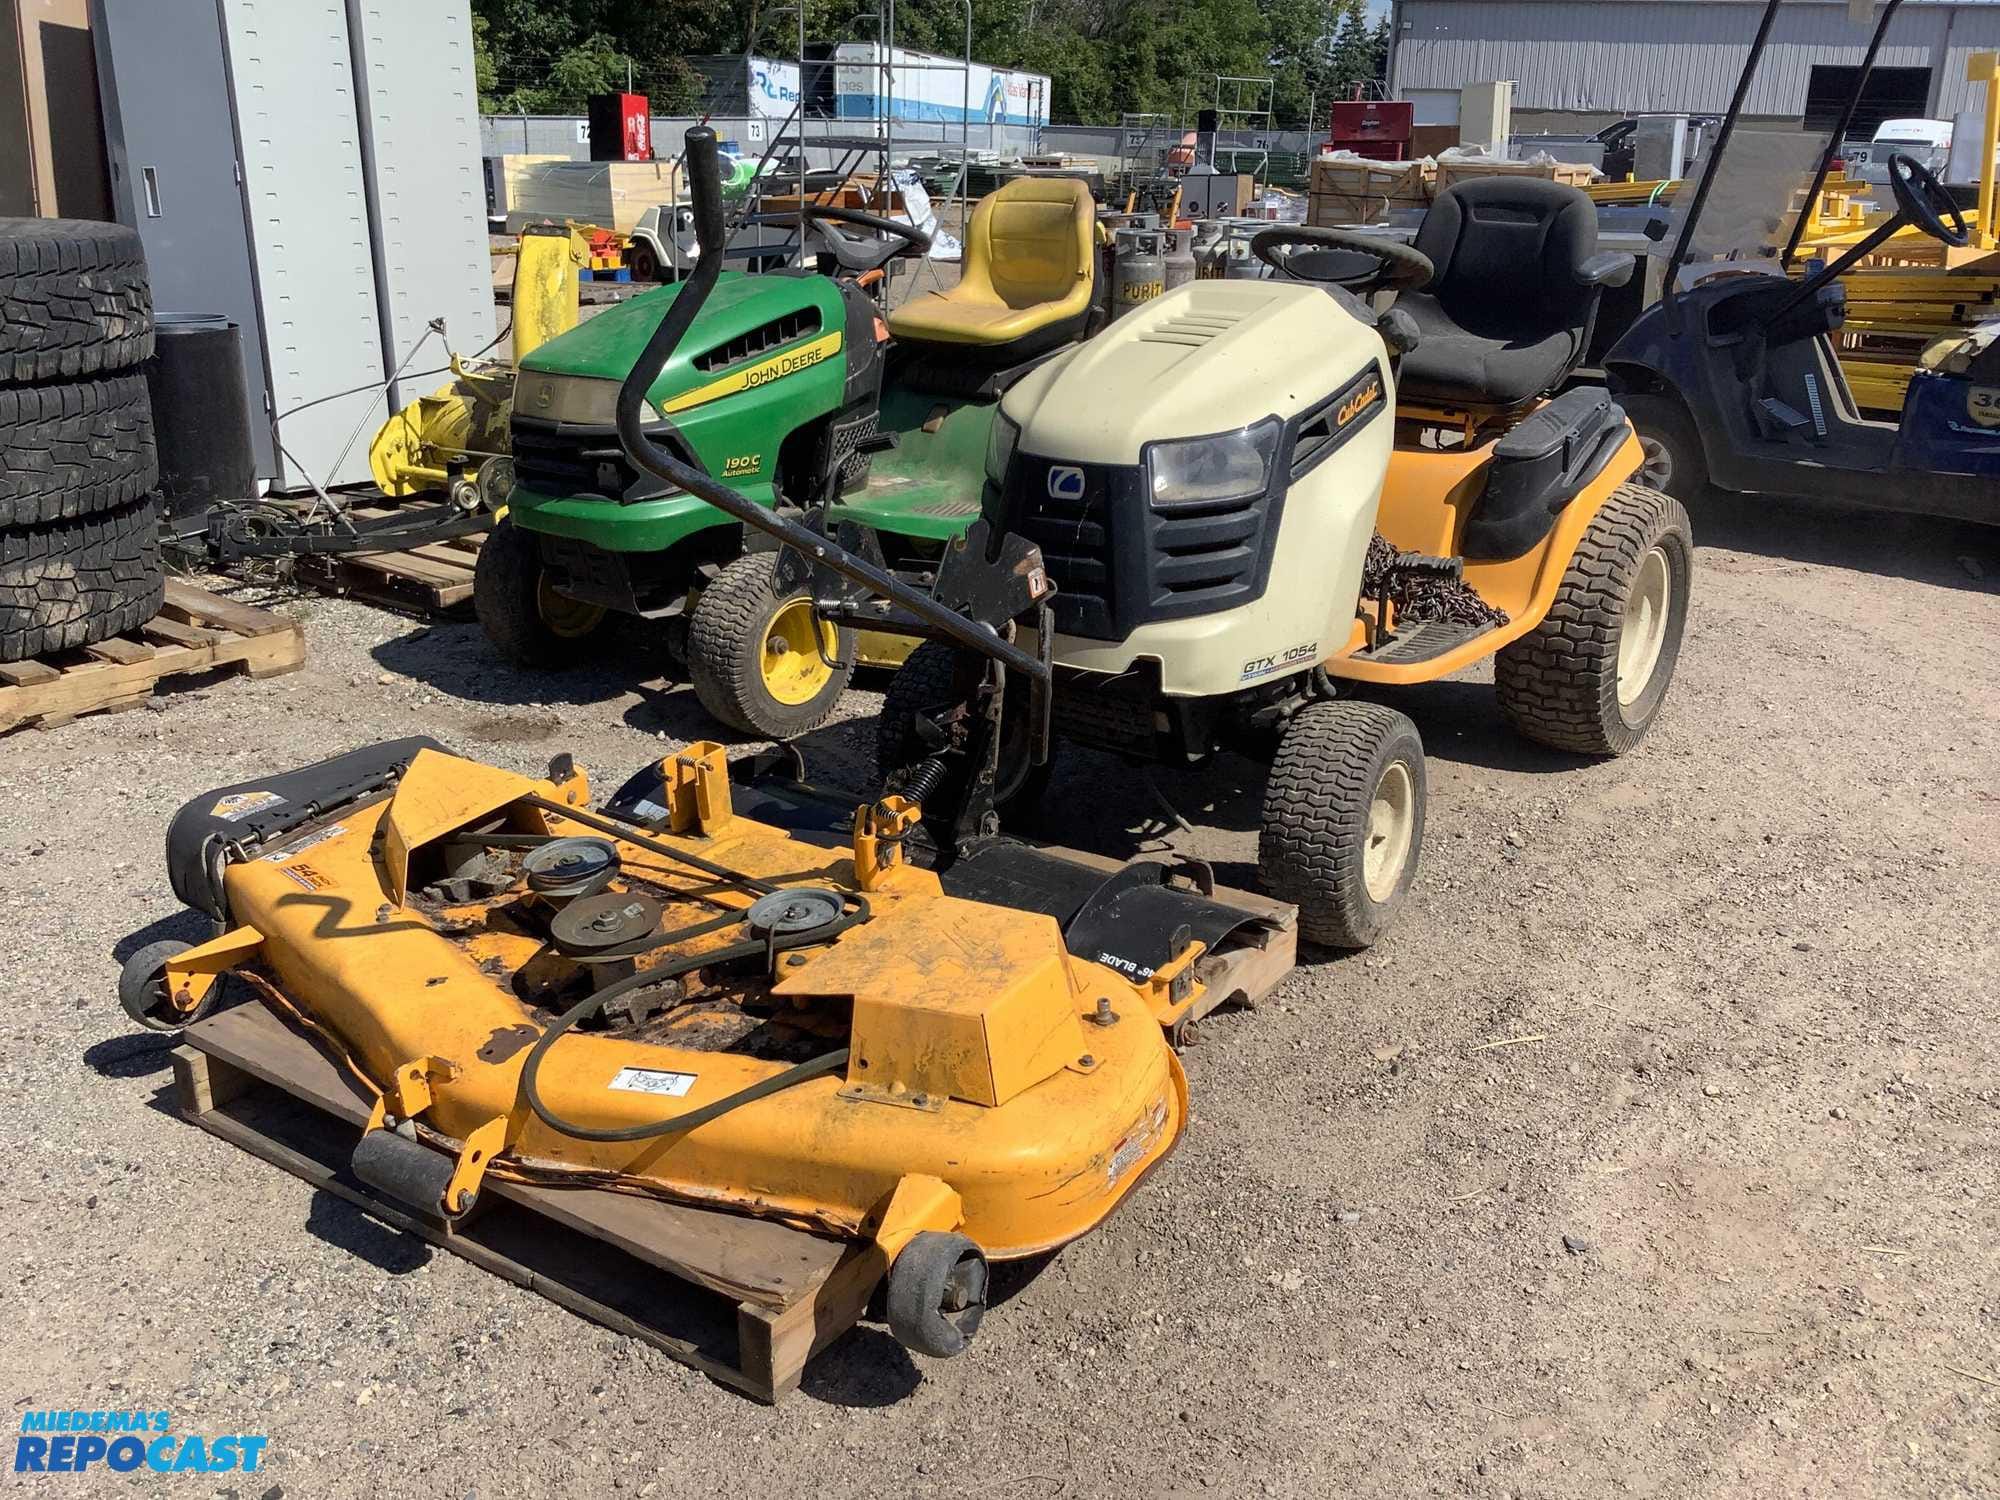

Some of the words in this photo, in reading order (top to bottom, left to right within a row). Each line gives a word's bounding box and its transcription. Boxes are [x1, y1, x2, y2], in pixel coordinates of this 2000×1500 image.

[752, 125, 760, 137] 73
[1854, 151, 1868, 162] 79
[742, 365, 779, 388] JOHN
[781, 348, 822, 373] DEERE
[1338, 399, 1355, 425] Cub
[1355, 380, 1377, 412] Cadet
[721, 466, 760, 478] Automatic
[1243, 655, 1277, 673] GTX
[1282, 642, 1317, 661] 1054
[291, 863, 318, 877] 54
[1100, 952, 1137, 972] BLADE
